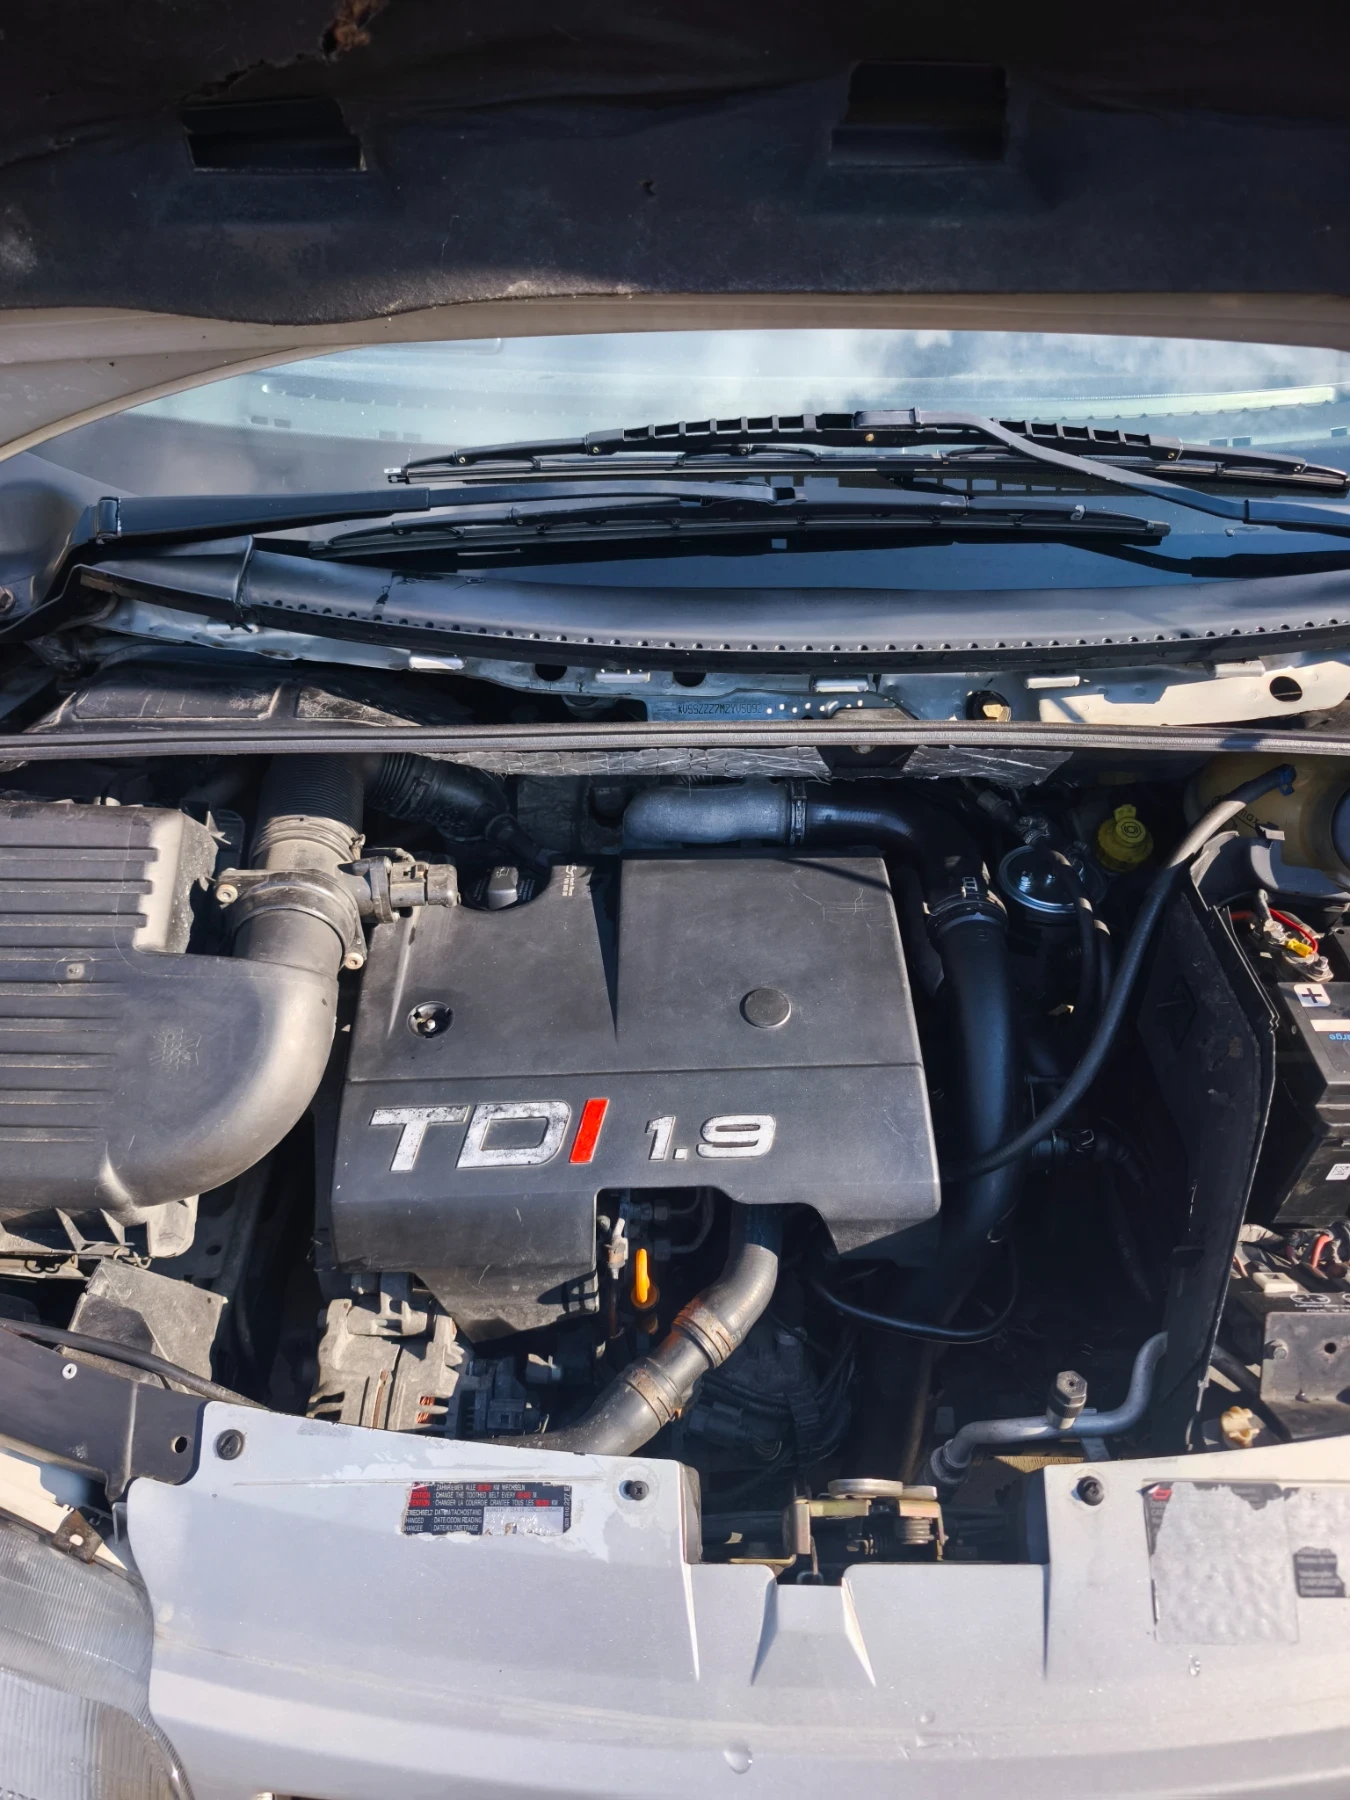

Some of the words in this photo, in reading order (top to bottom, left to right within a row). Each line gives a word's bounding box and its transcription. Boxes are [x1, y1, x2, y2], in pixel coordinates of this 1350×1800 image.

[369, 1097, 609, 1171] TDI
[645, 1114, 777, 1160] 1.9
[436, 1491, 454, 1499] CHANGE
[456, 1491, 464, 1499] THE
[466, 1491, 487, 1499] TOOTHED
[489, 1491, 500, 1499] BELT
[502, 1491, 516, 1499] EVERY
